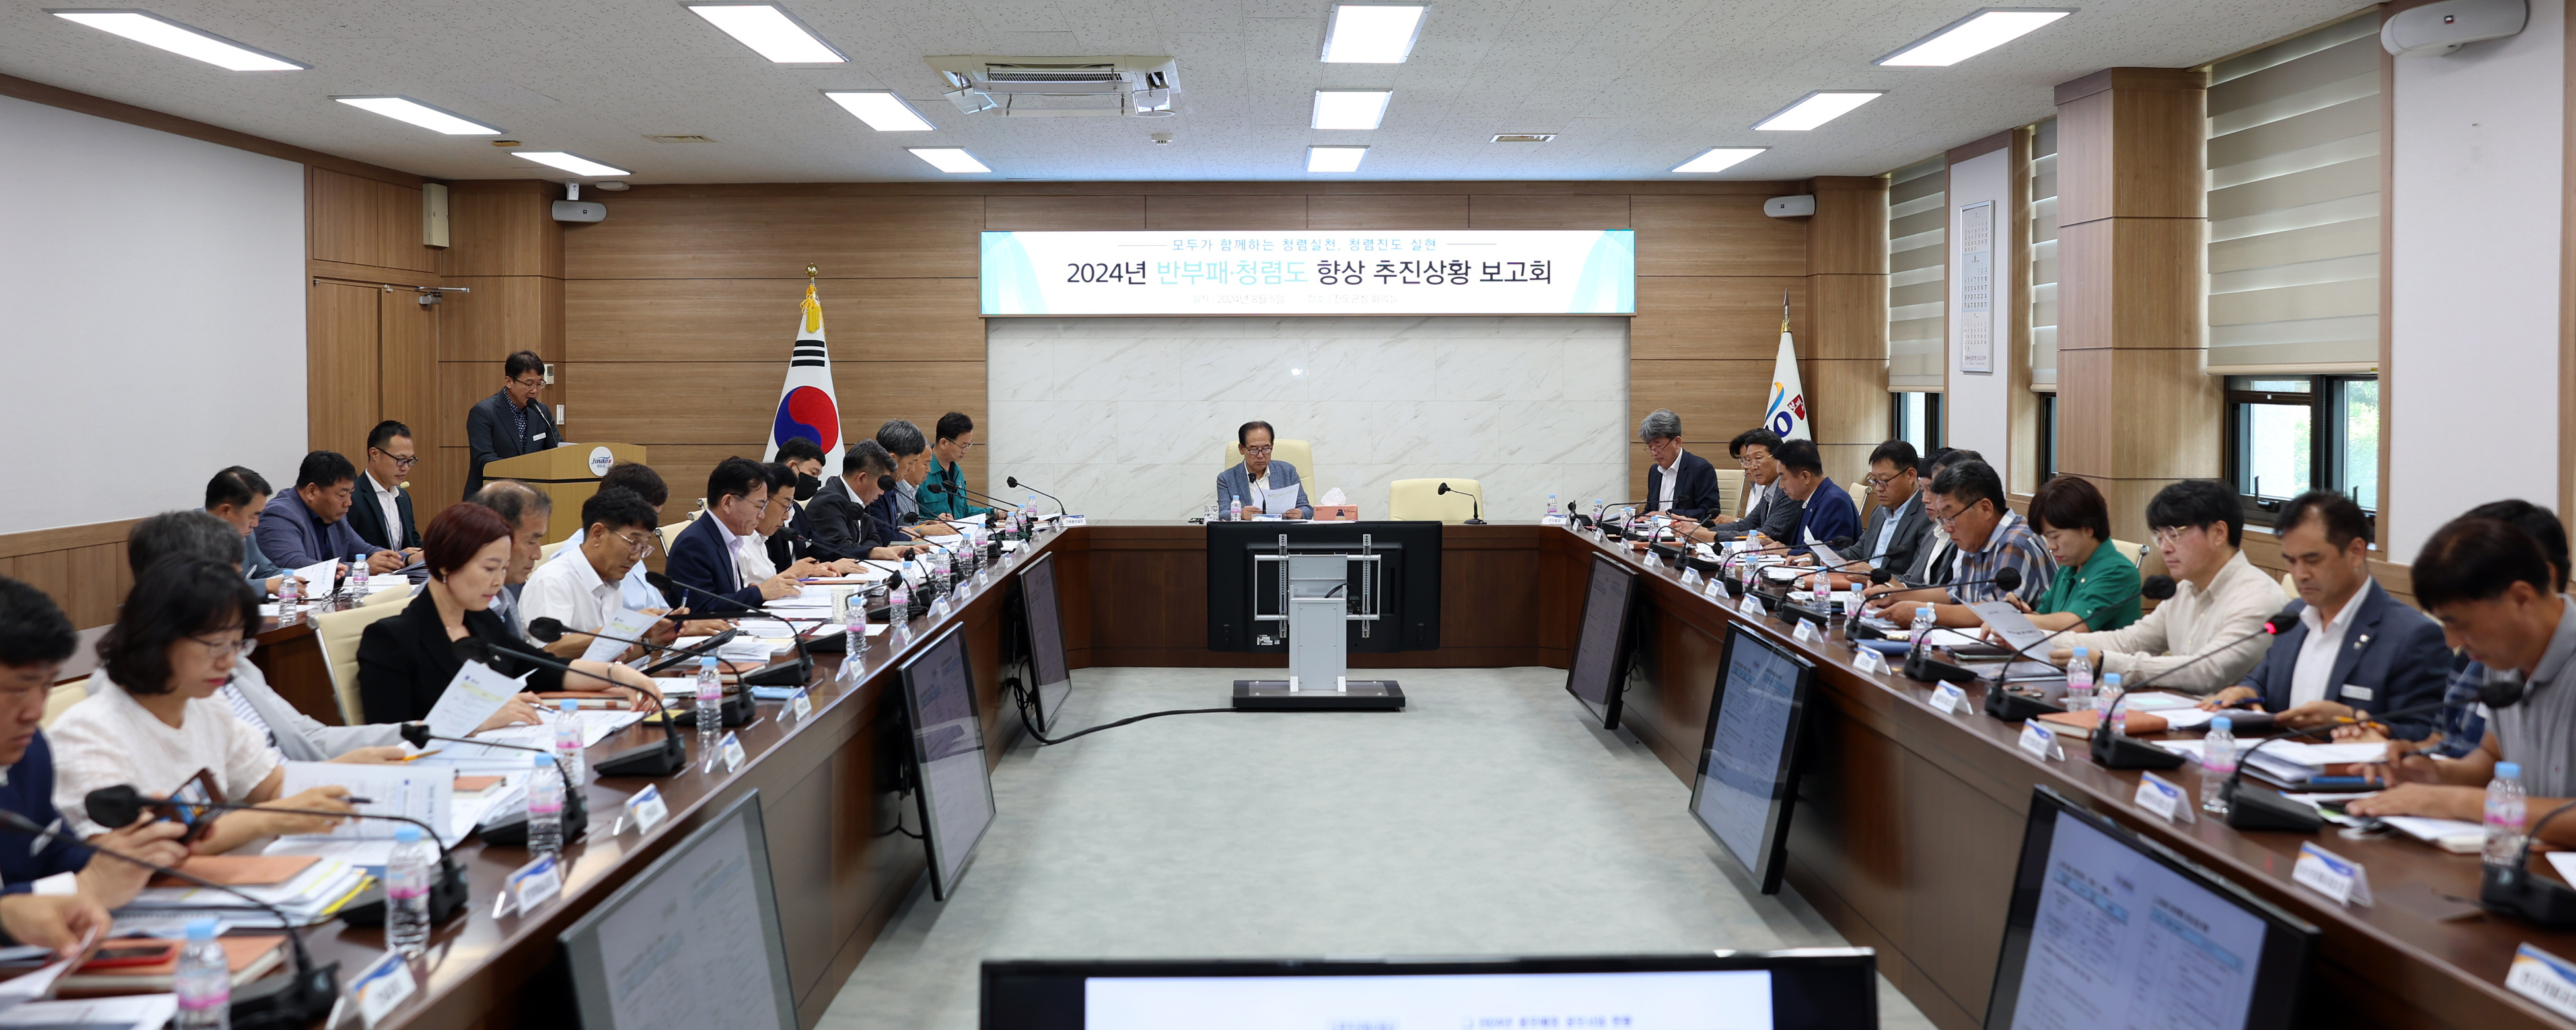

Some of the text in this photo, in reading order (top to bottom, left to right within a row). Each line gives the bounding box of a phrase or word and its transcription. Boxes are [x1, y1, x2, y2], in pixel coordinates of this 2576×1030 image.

[1172, 239, 1436, 251] 모두가 함께하는 청렴실천, 청렴진도 실현
[1067, 260, 1551, 285] 2024년 반부패·청렴도 향상 추진상황 보고회
[1217, 295, 1248, 304] 2024년
